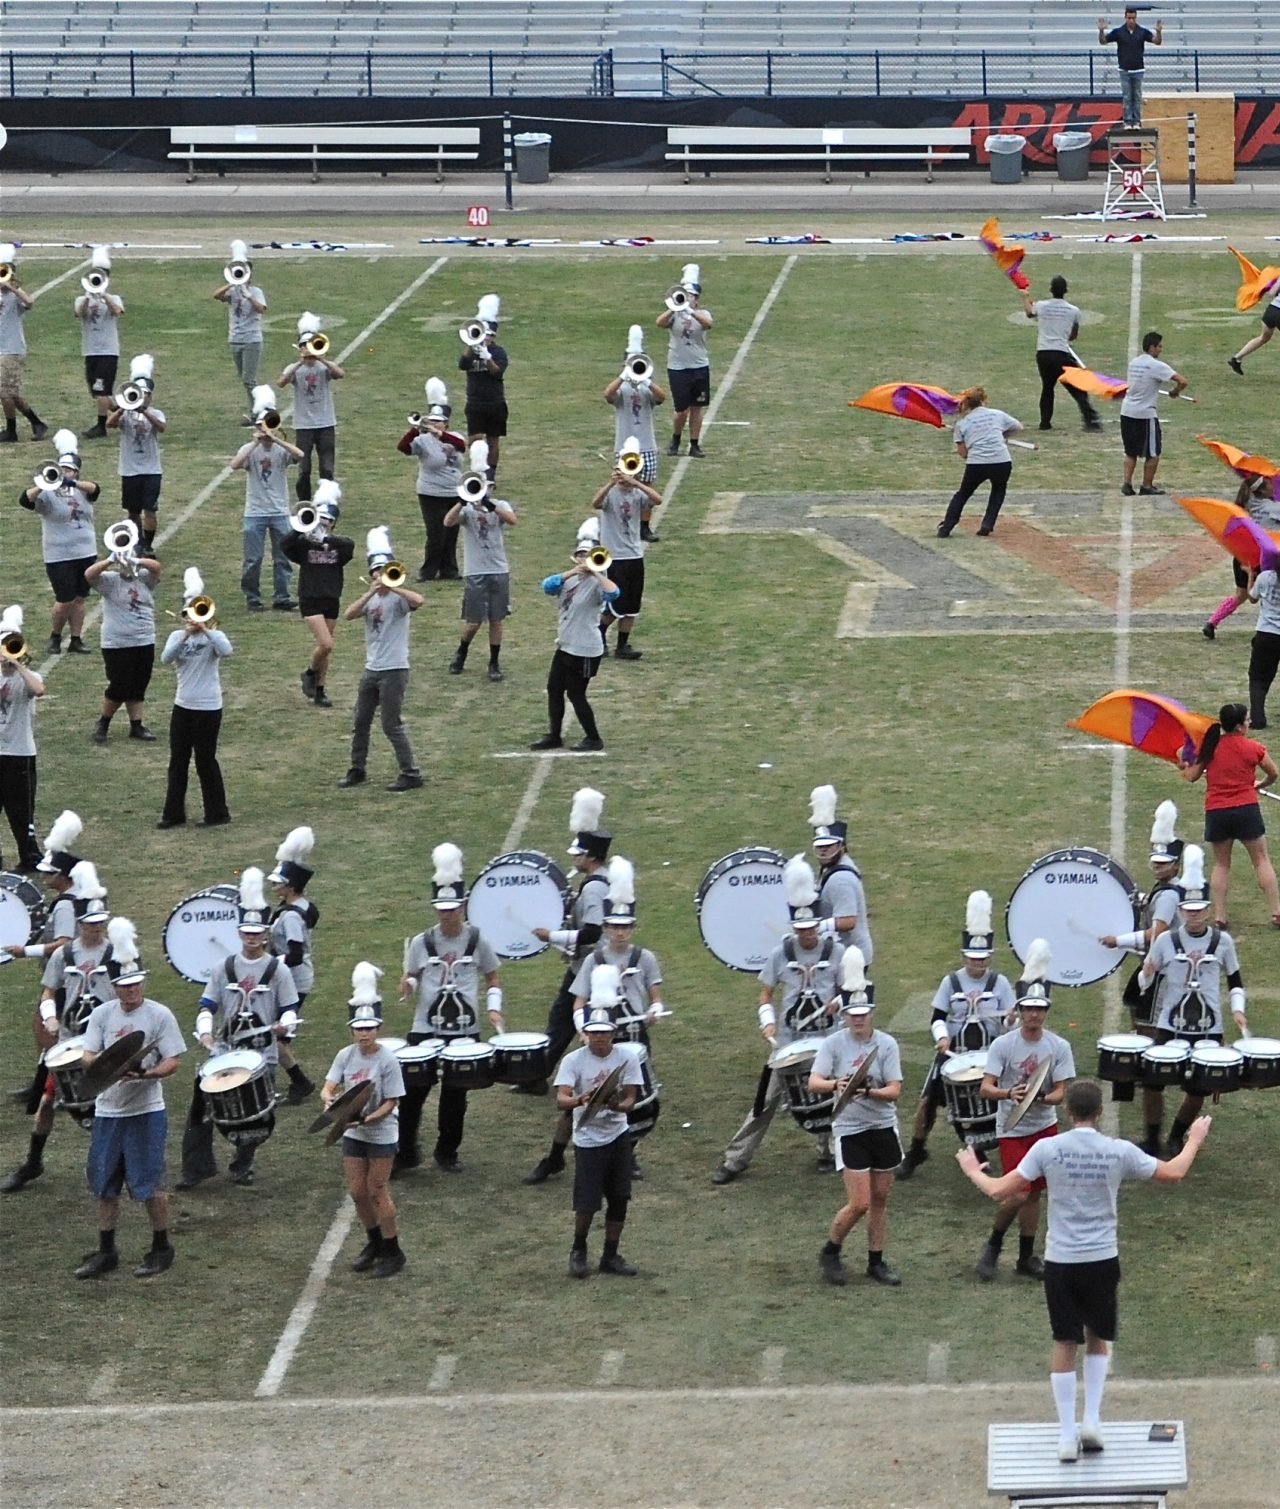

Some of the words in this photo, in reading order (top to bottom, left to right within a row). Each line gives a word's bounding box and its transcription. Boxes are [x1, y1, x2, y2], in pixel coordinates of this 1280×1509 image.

[1124, 171, 1142, 186] 50
[469, 207, 488, 225] 40
[500, 875, 540, 887] YAMAHA
[742, 874, 783, 886] YAMAHA
[1057, 873, 1098, 884] YAMAHA
[194, 910, 237, 922] YAMAHA
